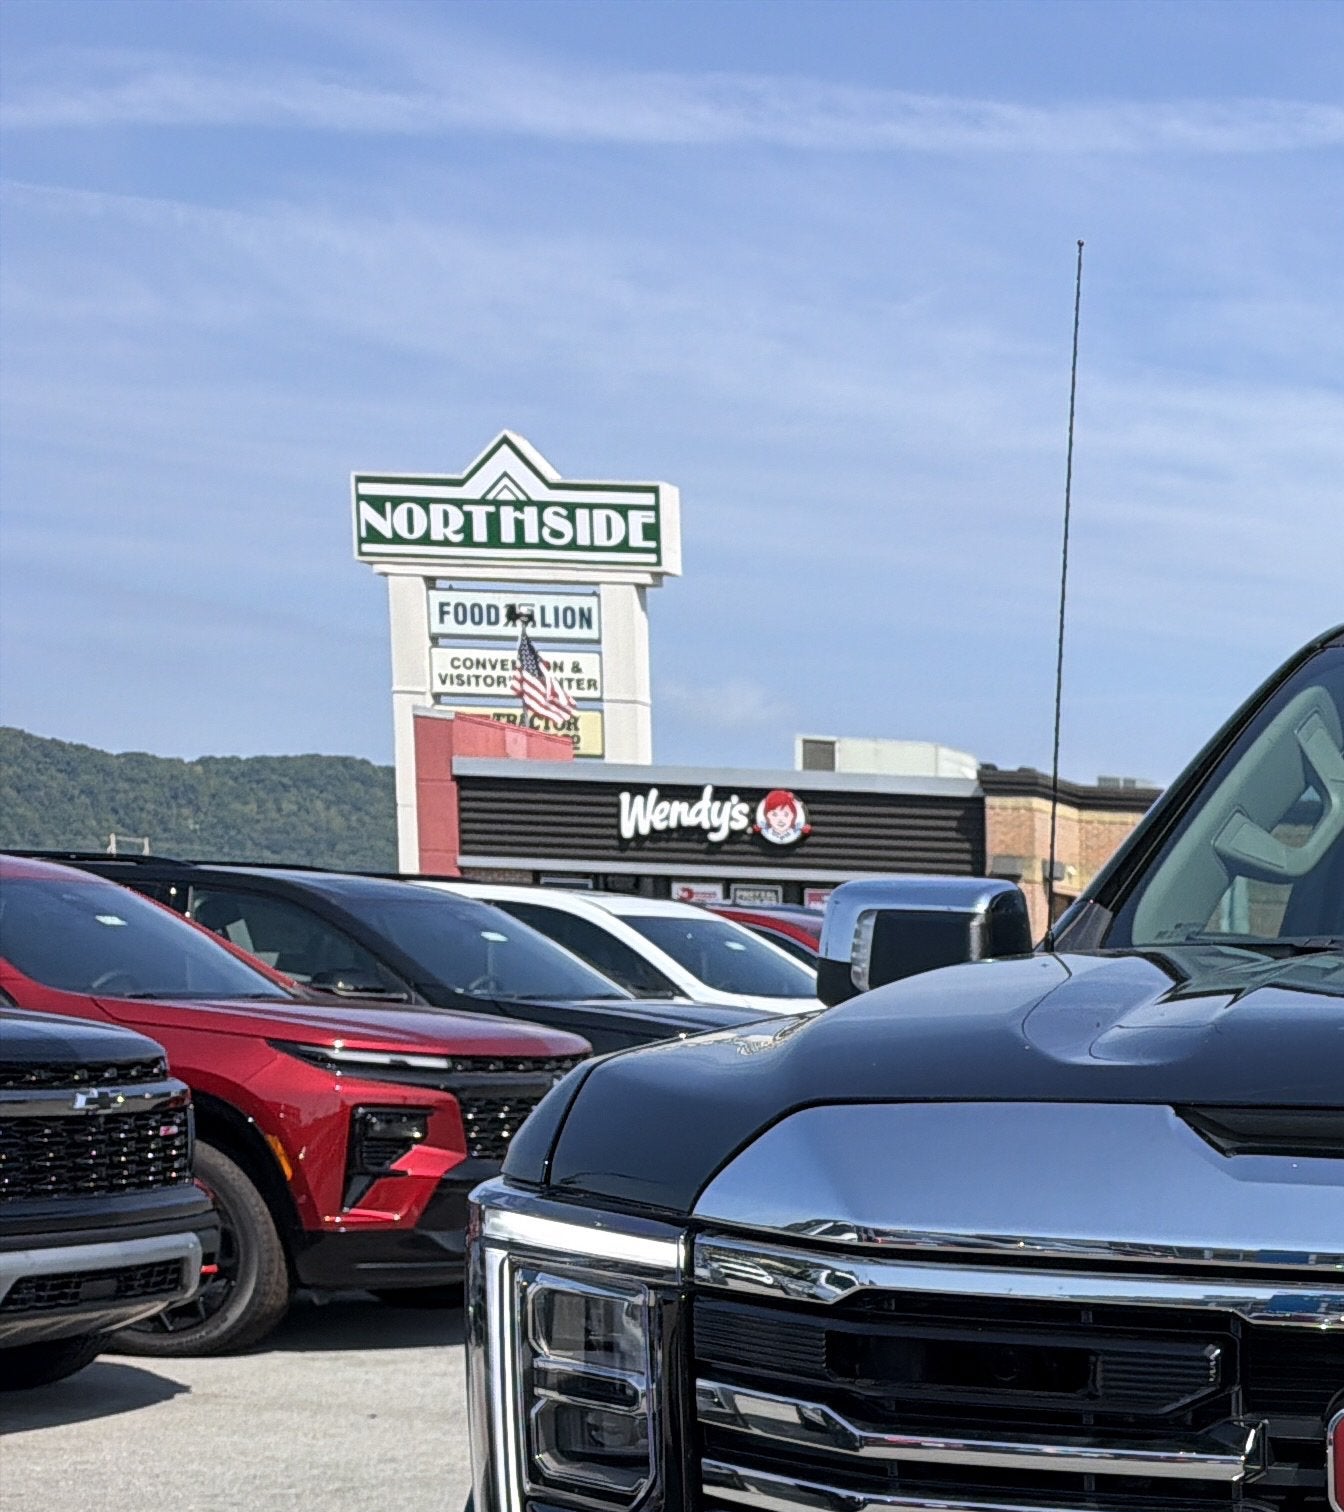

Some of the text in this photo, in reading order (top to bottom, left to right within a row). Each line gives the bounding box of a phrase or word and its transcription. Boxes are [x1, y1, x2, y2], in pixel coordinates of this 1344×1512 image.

[359, 501, 657, 548] NORTHSIDE
[438, 602, 593, 630] FOOD LION
[571, 660, 583, 674] &
[619, 785, 751, 843] Wendy's
